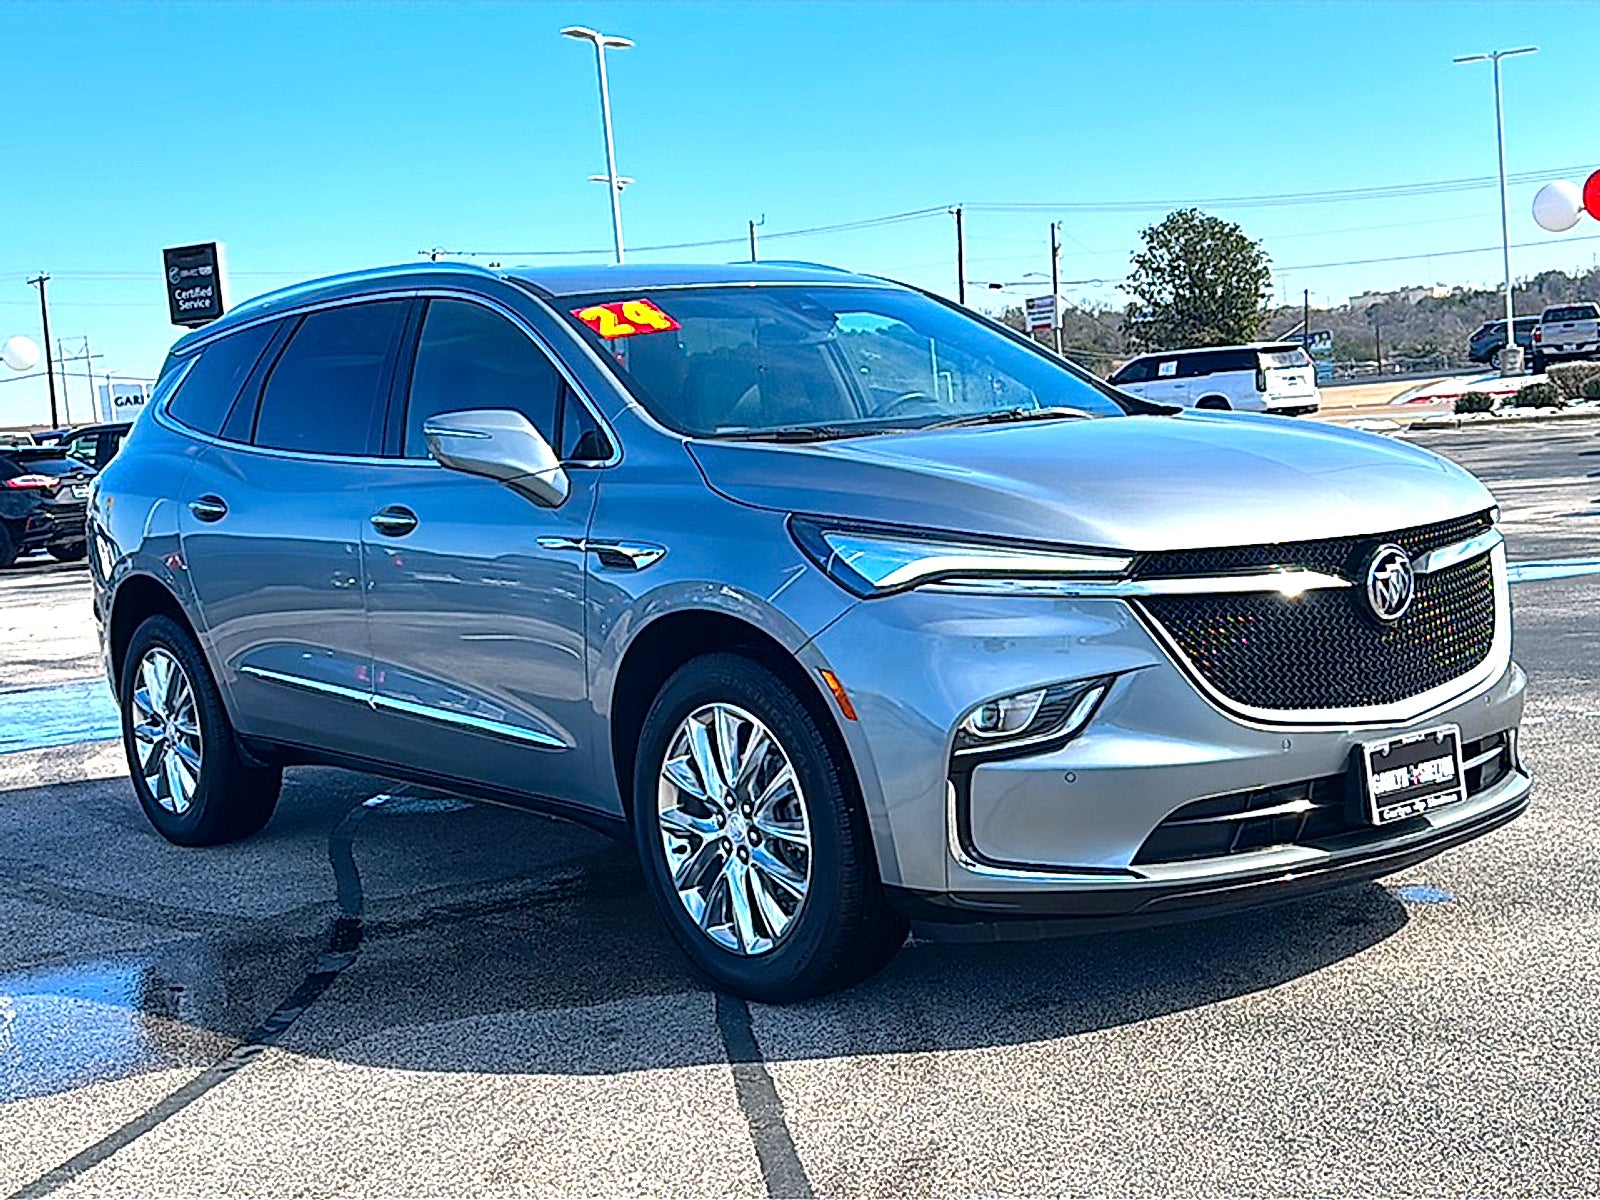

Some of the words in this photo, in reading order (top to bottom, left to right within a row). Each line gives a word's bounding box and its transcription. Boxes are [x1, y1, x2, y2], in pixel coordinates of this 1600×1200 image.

[175, 286, 212, 300] Certified
[179, 298, 211, 310] Service
[578, 300, 671, 338] 24
